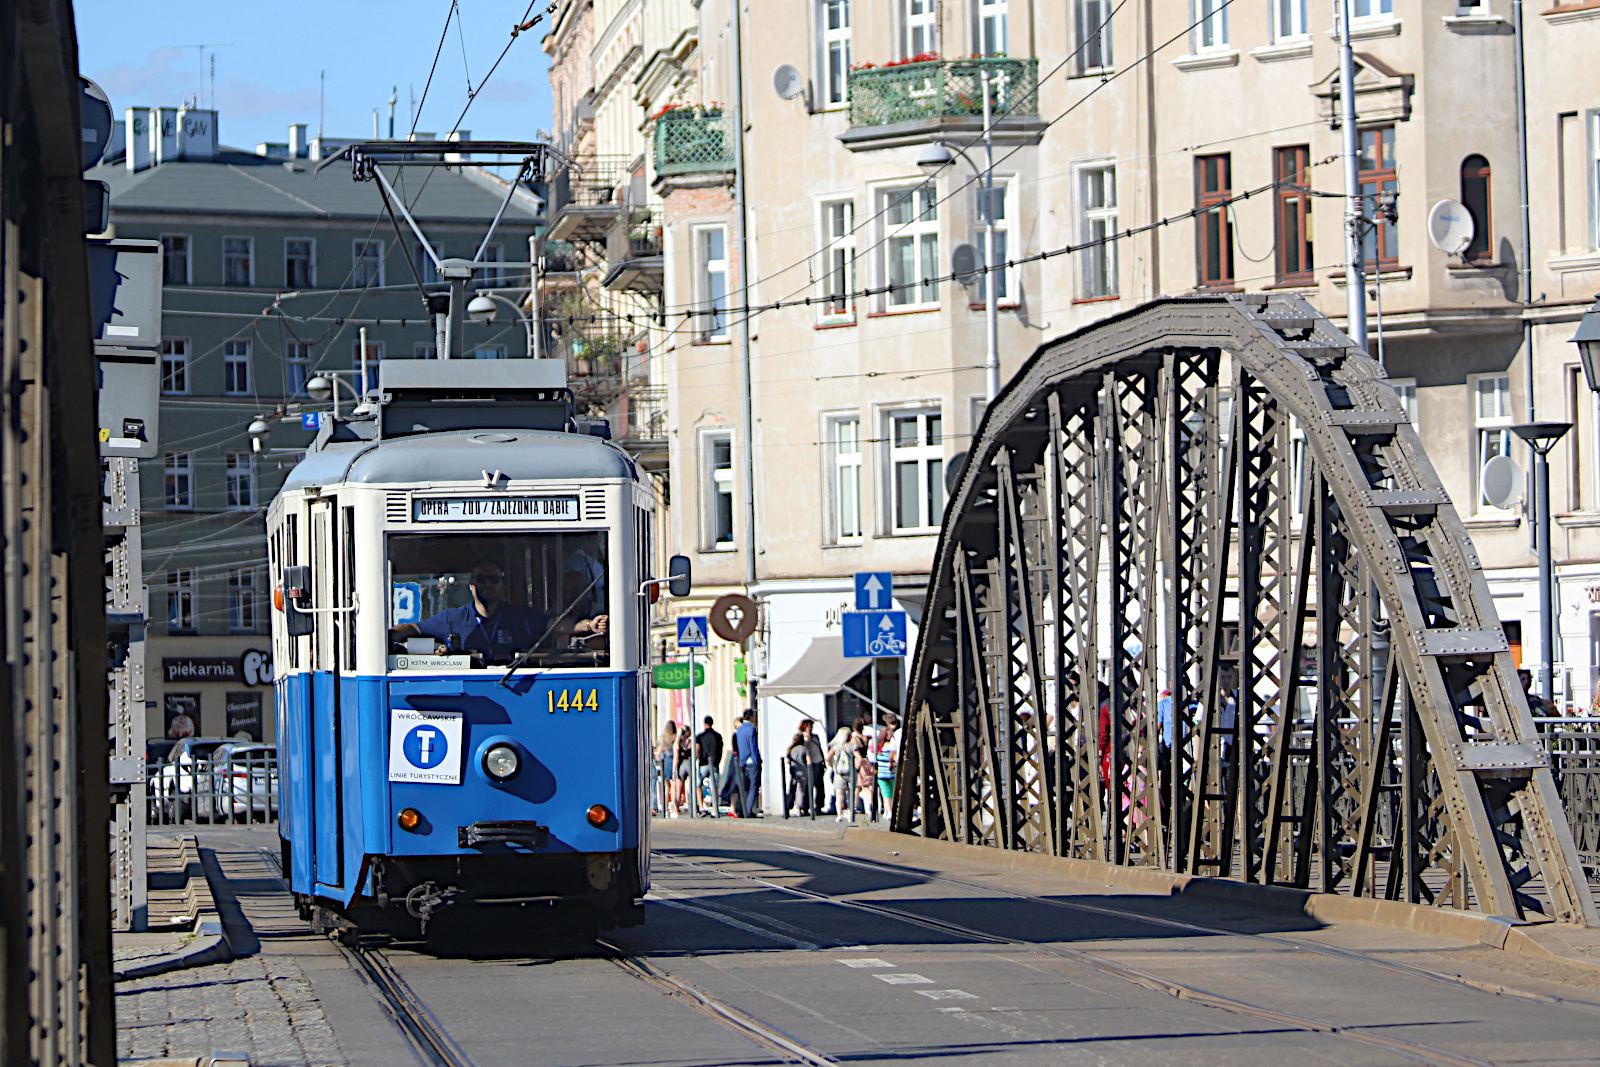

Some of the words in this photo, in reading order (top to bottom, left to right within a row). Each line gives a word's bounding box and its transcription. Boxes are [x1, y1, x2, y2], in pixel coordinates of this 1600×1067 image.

[421, 501, 449, 515] OPERA
[543, 500, 569, 515] DĄBIE
[168, 661, 235, 680] piekarnia
[657, 667, 701, 681] żabka
[547, 689, 599, 713] 1444
[398, 713, 457, 722] WROCŁAWSKIE
[416, 730, 436, 763] T
[409, 773, 458, 781] TURYSTYCZNE
